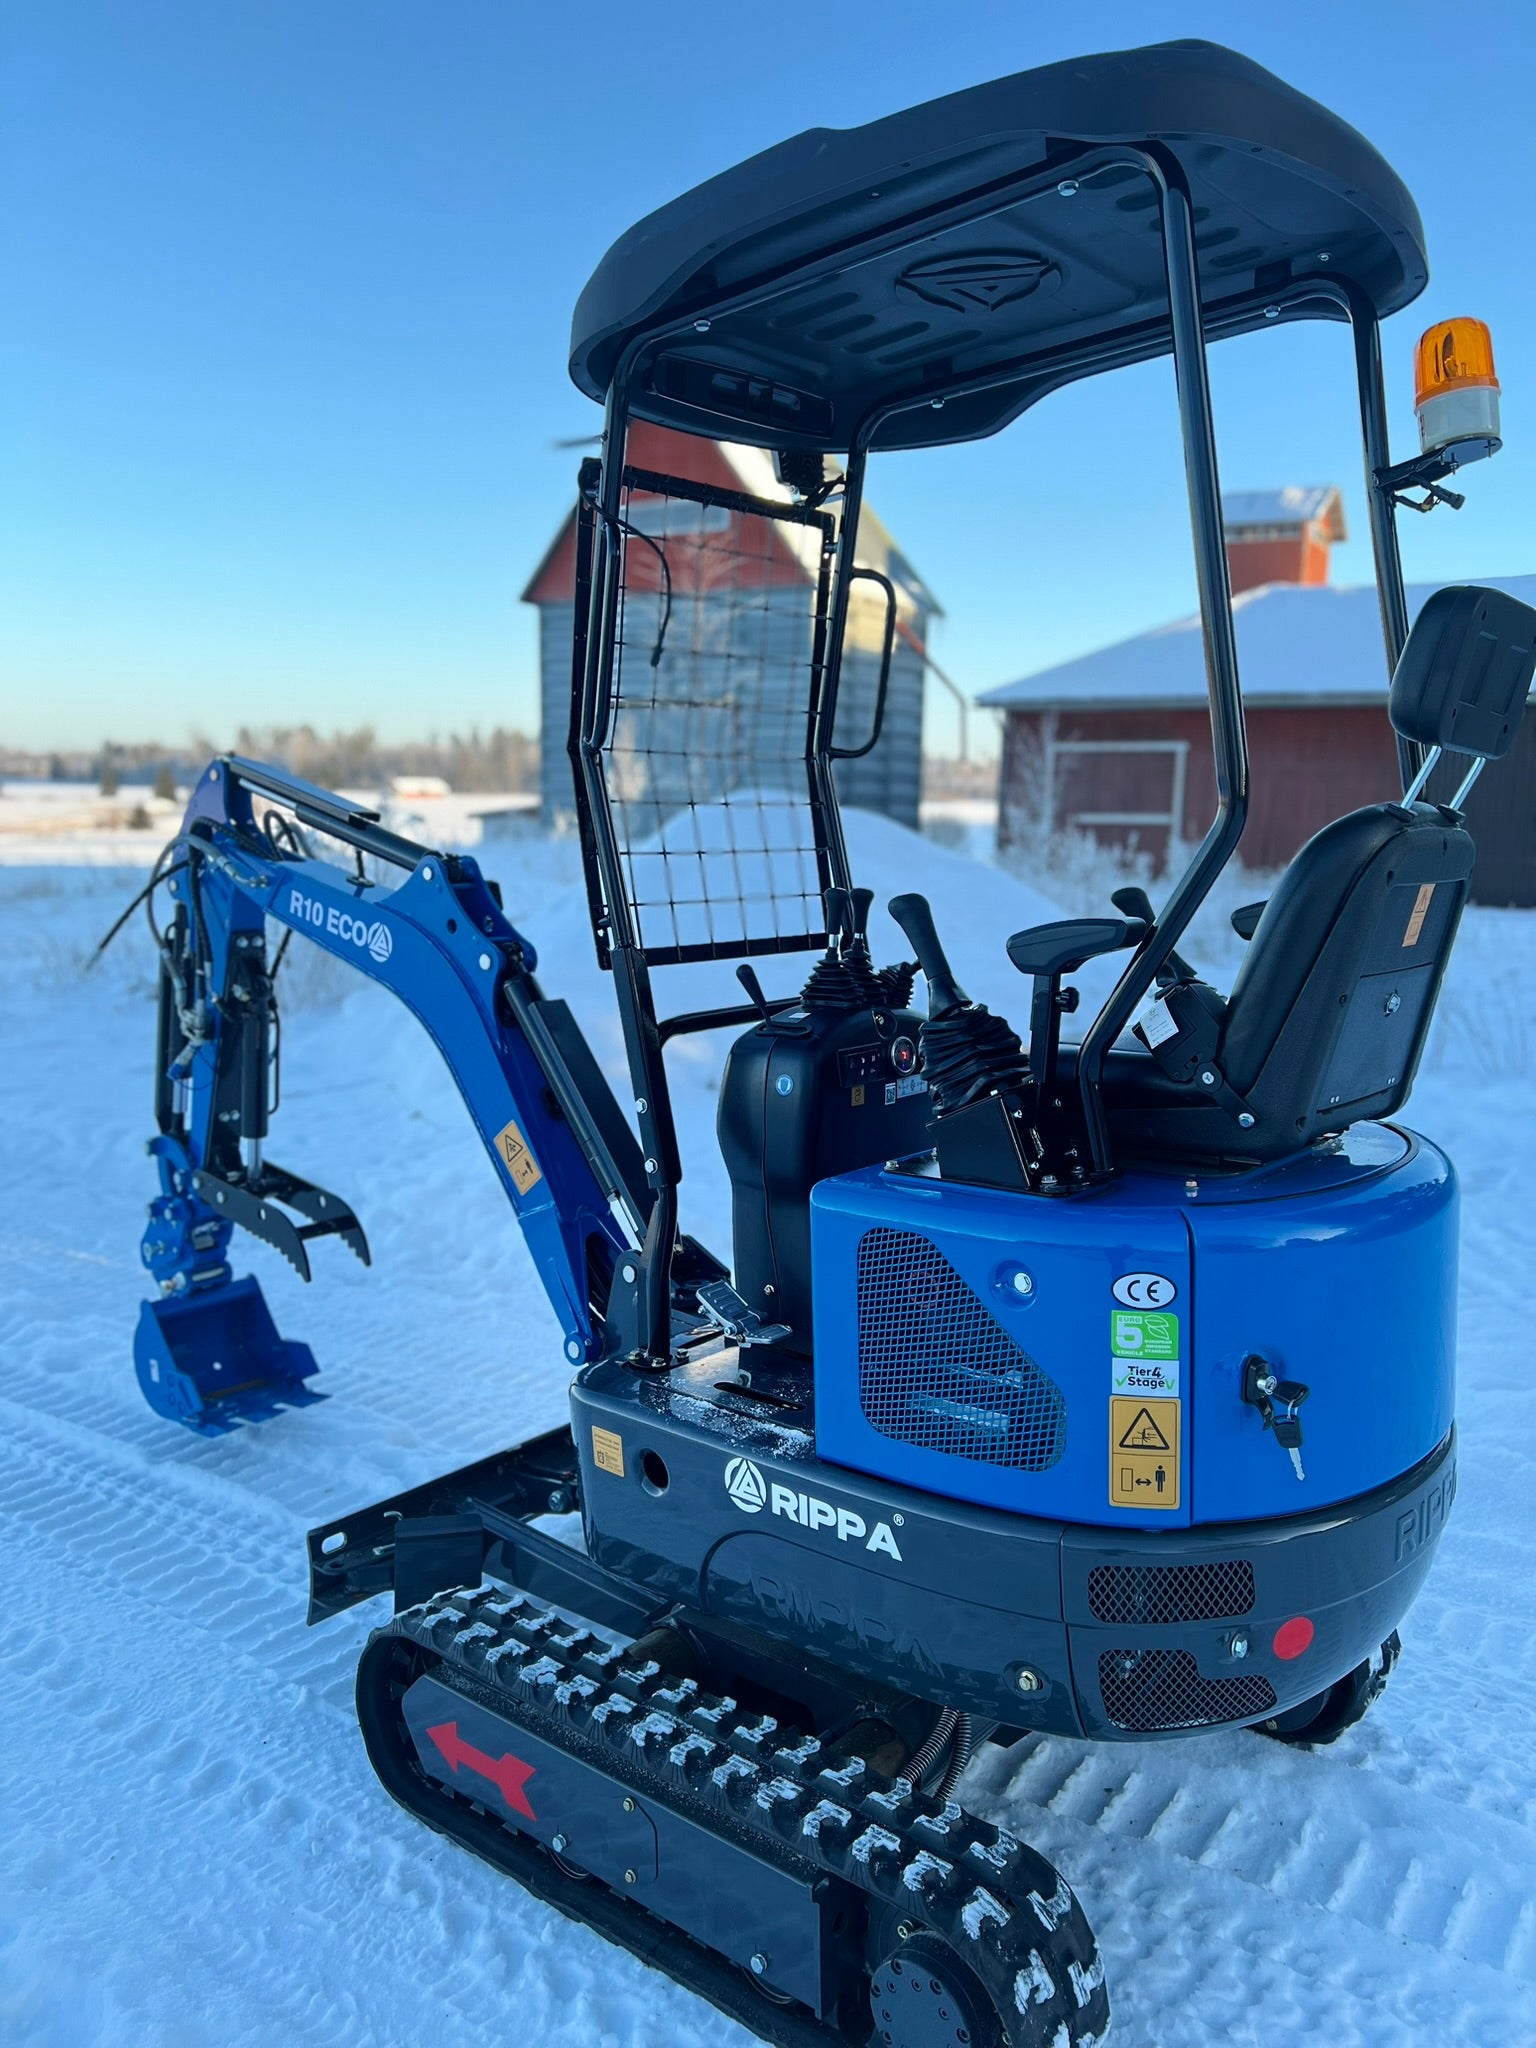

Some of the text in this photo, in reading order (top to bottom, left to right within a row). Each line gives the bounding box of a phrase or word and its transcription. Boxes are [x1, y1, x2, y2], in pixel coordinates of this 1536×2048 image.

[290, 890, 368, 947] R10 ECO
[1127, 1280, 1161, 1302] CE
